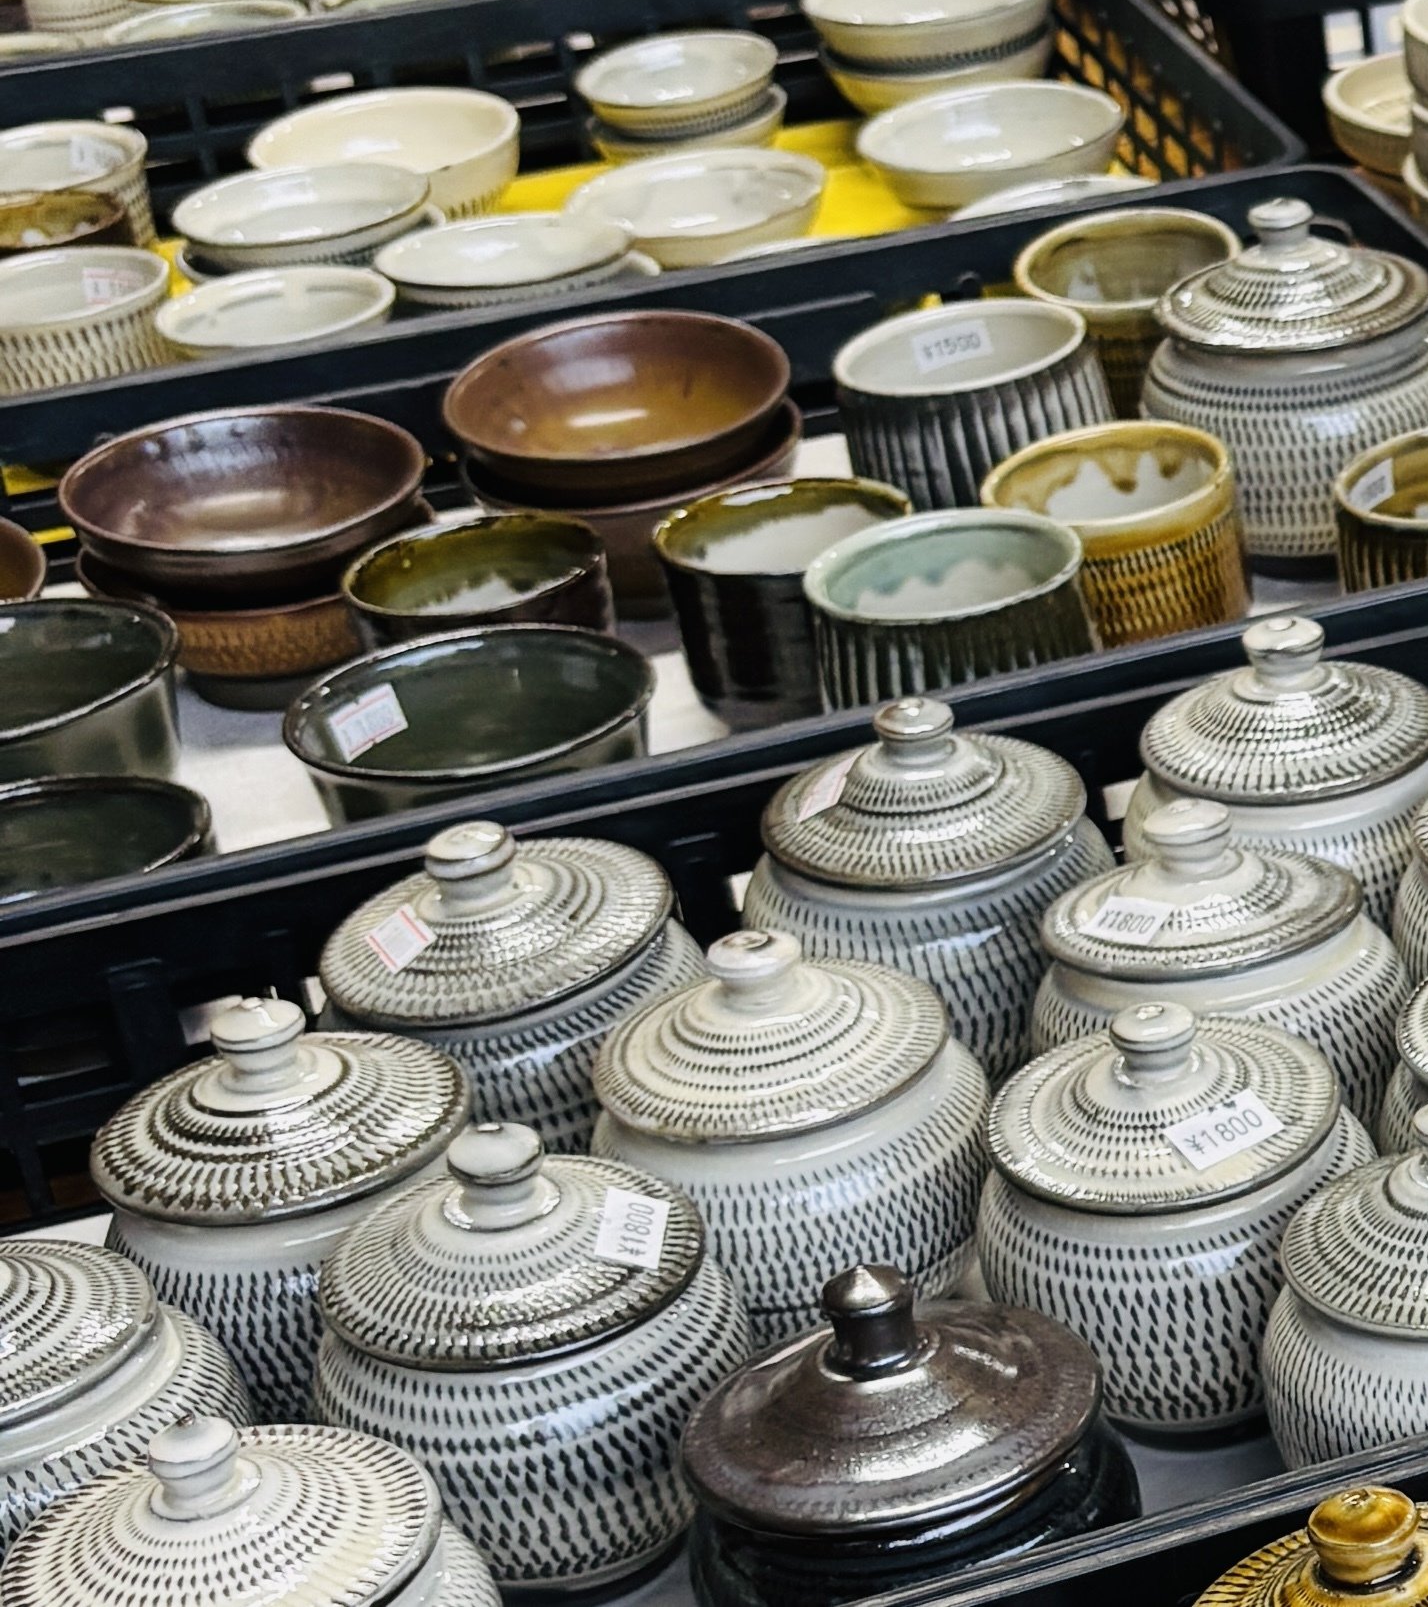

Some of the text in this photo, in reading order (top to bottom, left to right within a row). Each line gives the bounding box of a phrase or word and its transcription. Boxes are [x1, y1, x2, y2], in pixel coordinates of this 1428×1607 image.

[1098, 909, 1157, 935] ¥1800
[1184, 1108, 1263, 1155] ¥1800
[617, 1202, 656, 1257] ¥1800
